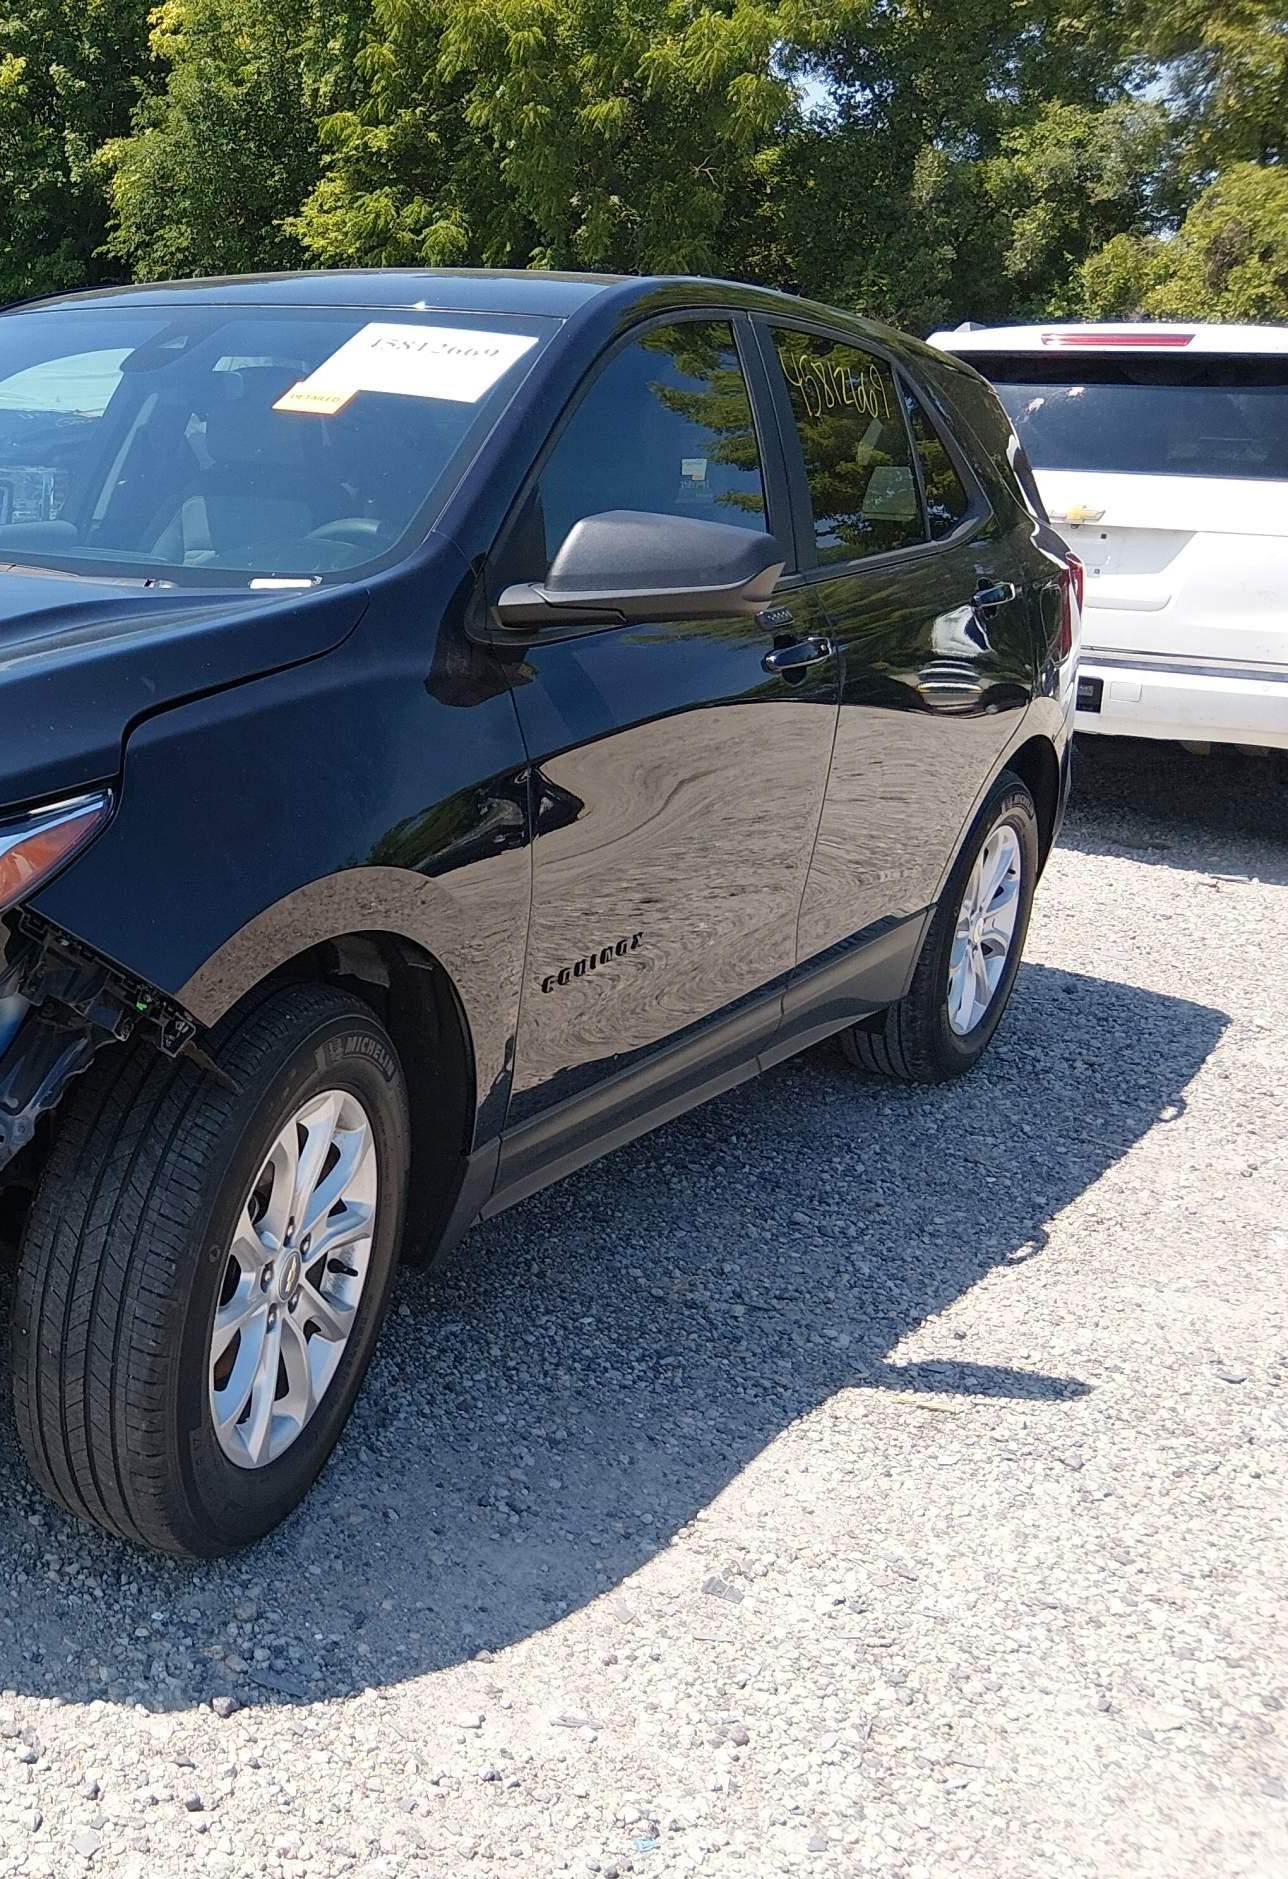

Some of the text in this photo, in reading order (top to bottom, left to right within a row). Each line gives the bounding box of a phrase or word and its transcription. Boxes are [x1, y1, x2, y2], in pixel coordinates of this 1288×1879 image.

[777, 347, 890, 419] 45812669
[541, 931, 644, 994] EQUINOX
[344, 1035, 397, 1077] MICHELIN
